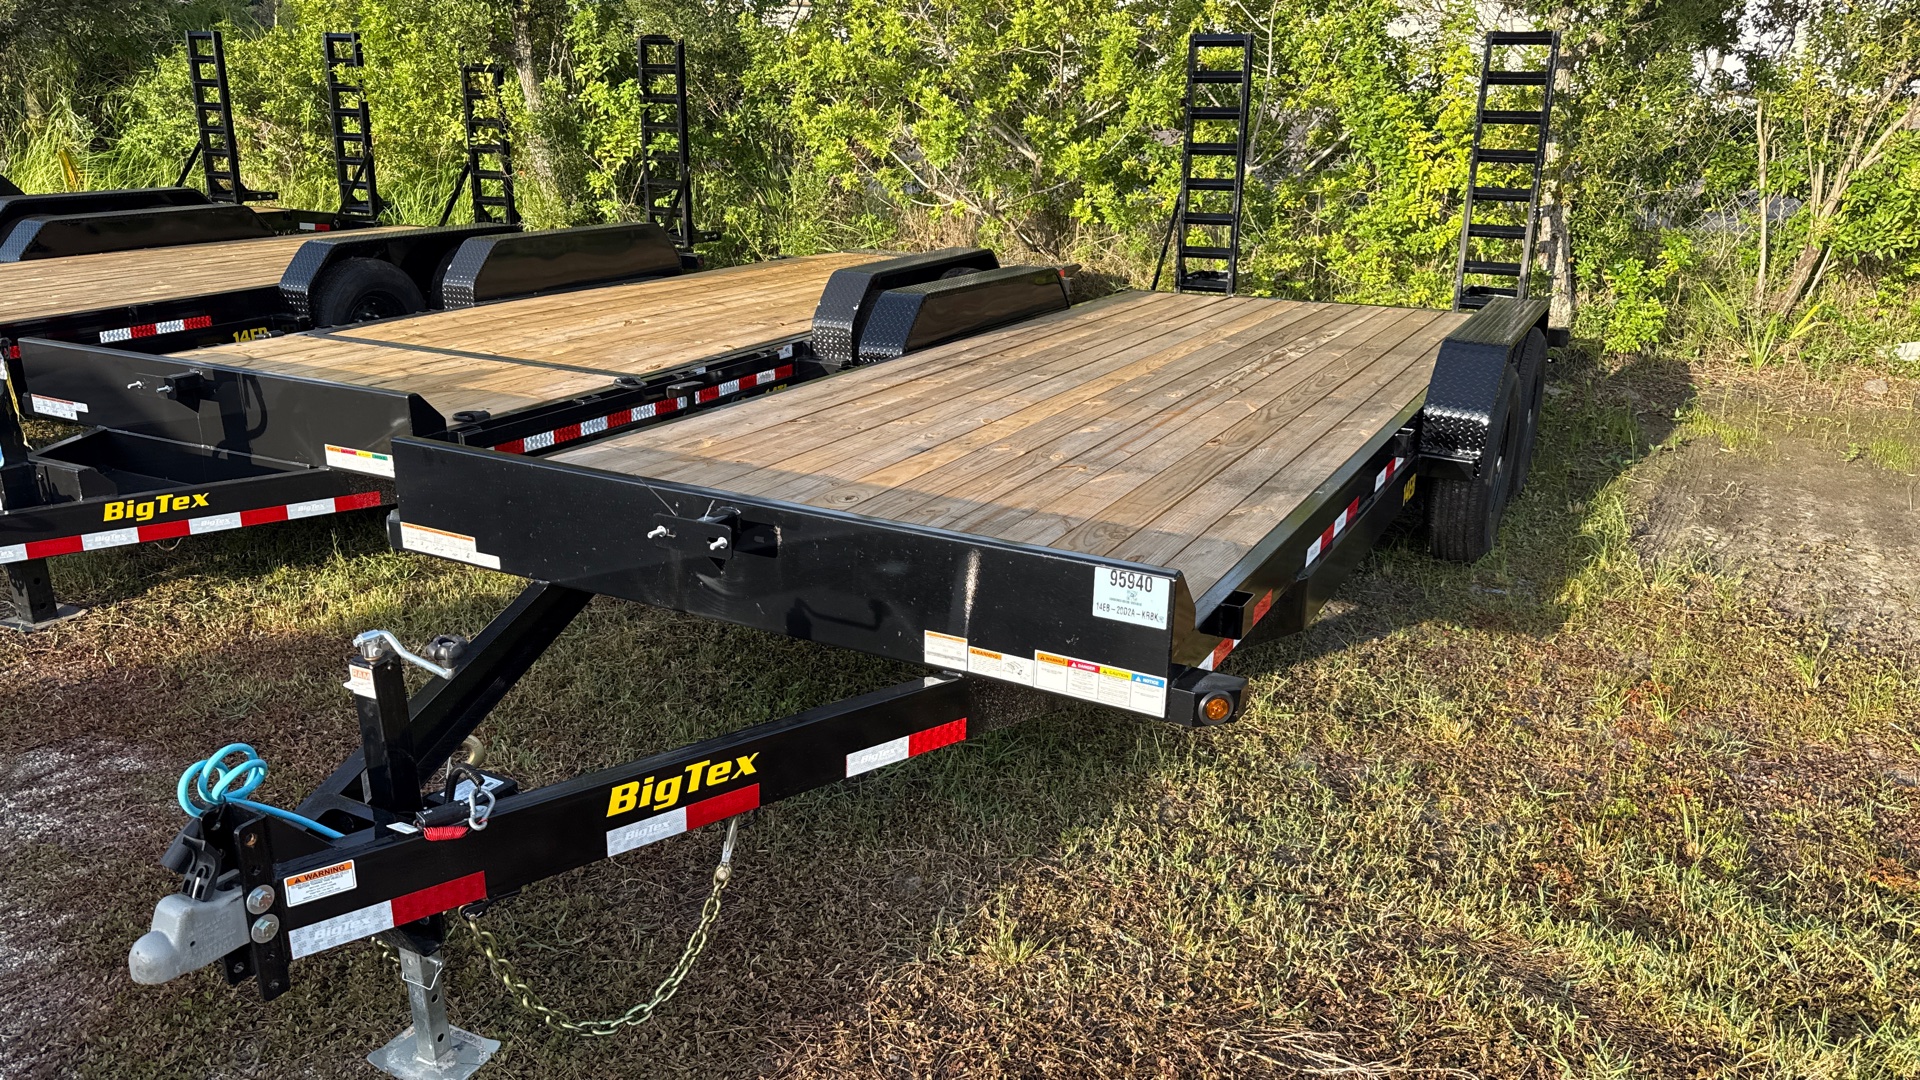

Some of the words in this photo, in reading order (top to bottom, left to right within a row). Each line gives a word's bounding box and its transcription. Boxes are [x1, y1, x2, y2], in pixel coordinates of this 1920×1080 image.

[103, 492, 210, 522] BigTex
[200, 517, 231, 527] BigTex
[1110, 569, 1153, 593] 95940
[1077, 663, 1096, 672] DANGER
[1142, 676, 1160, 687] NOTICE
[606, 752, 760, 819] BigTex
[624, 820, 671, 841] BigTex
[304, 864, 346, 881] WARNING
[314, 917, 372, 941] BigTex
